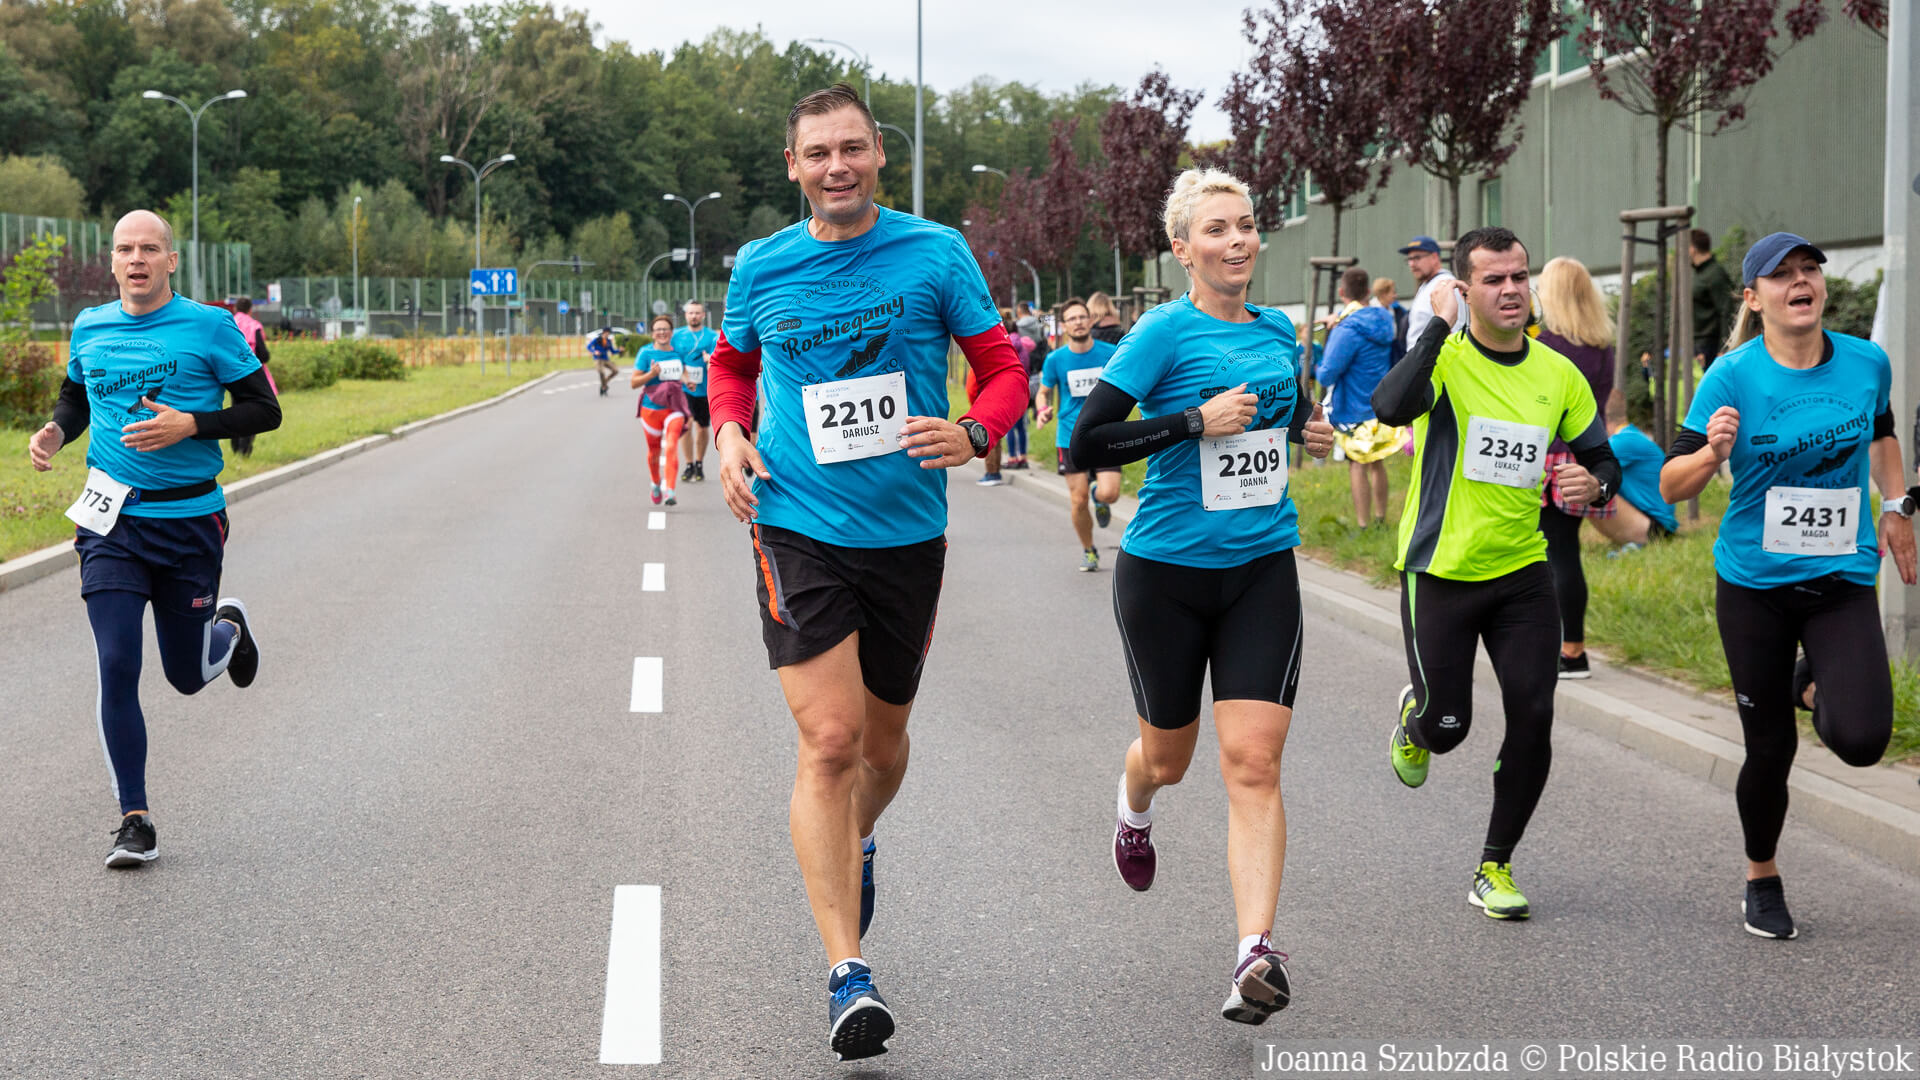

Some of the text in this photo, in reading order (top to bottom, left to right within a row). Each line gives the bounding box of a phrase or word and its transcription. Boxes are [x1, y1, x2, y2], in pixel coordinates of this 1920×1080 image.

[782, 296, 904, 360] Rozbiegamy
[93, 360, 177, 401] Rozbiegamy
[820, 395, 895, 428] 2210
[842, 425, 879, 439] DARIUSZ
[1758, 412, 1869, 467] Rozbiegamy
[1218, 448, 1279, 477] 2209
[1479, 436, 1537, 463] 2343
[1494, 460, 1520, 472] ŁUKASZ
[1239, 476, 1268, 487] JOANNA
[83, 488, 113, 513] 775
[1781, 506, 1847, 527] 2431
[1801, 529, 1830, 538] MAGDA
